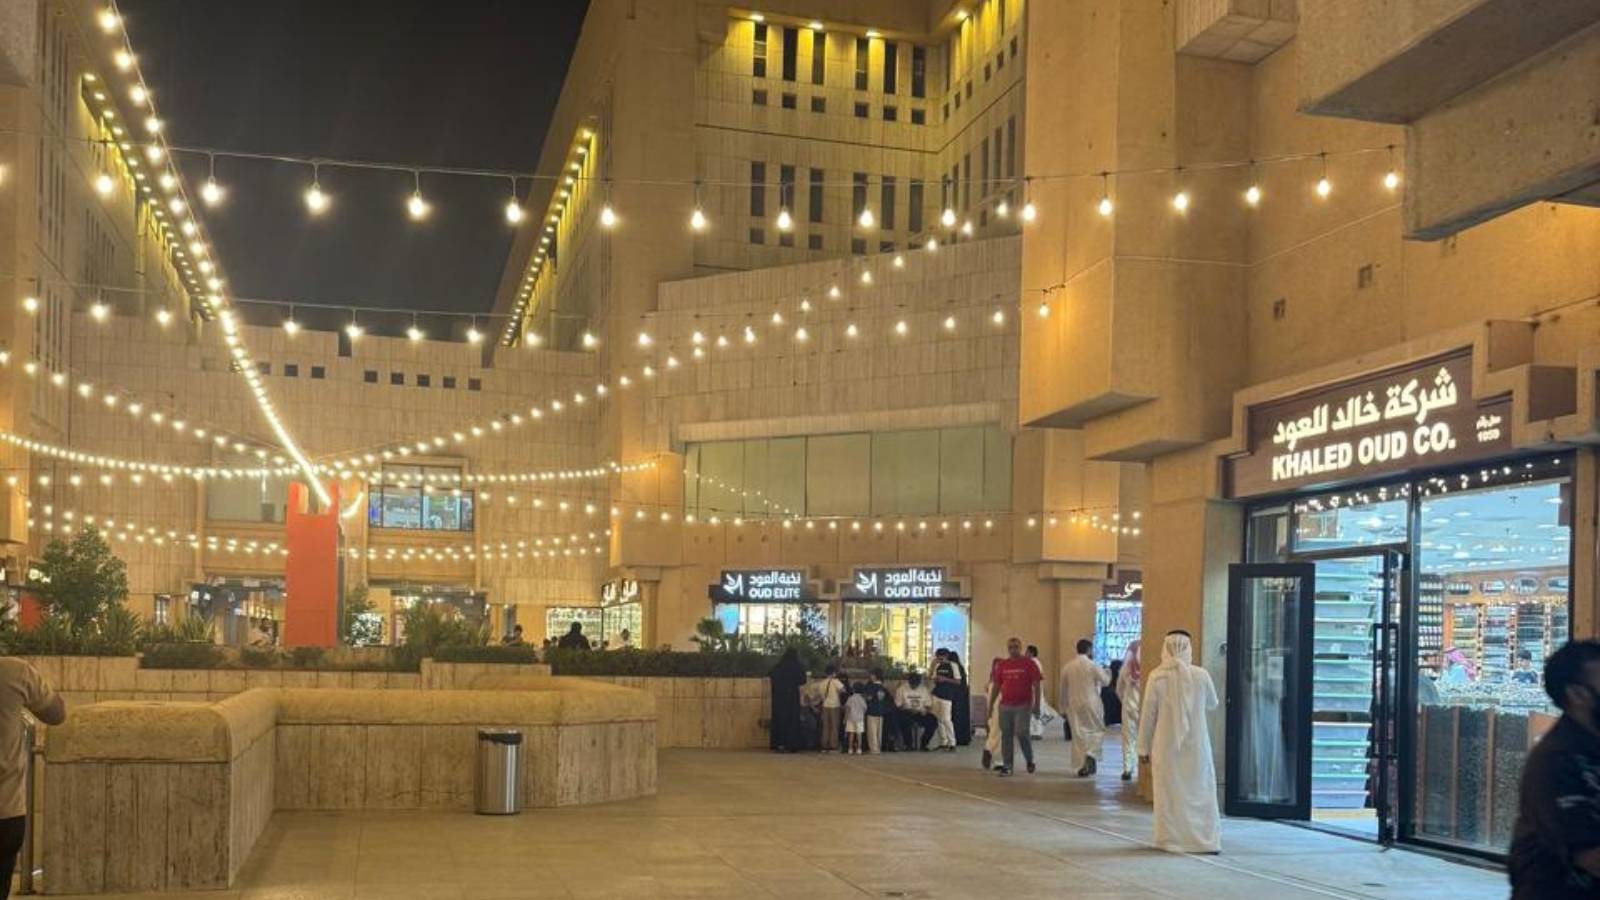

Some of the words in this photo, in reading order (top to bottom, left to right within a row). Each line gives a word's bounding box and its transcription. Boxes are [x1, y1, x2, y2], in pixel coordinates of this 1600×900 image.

[1384, 367, 1458, 424] شركة
[1331, 391, 1381, 430] خالد
[1273, 404, 1328, 451] للعود
[1271, 443, 1353, 482] KHALED
[1358, 431, 1408, 465] OUD
[1413, 422, 1456, 454] CO.
[749, 571, 778, 587] العود
[778, 572, 801, 586] نخبة
[884, 568, 917, 585] العود
[917, 569, 942, 584] نخبة
[748, 587, 772, 599] OUD
[773, 587, 800, 599] ELITE
[884, 586, 910, 598] OUD
[912, 586, 941, 598] ELITE
